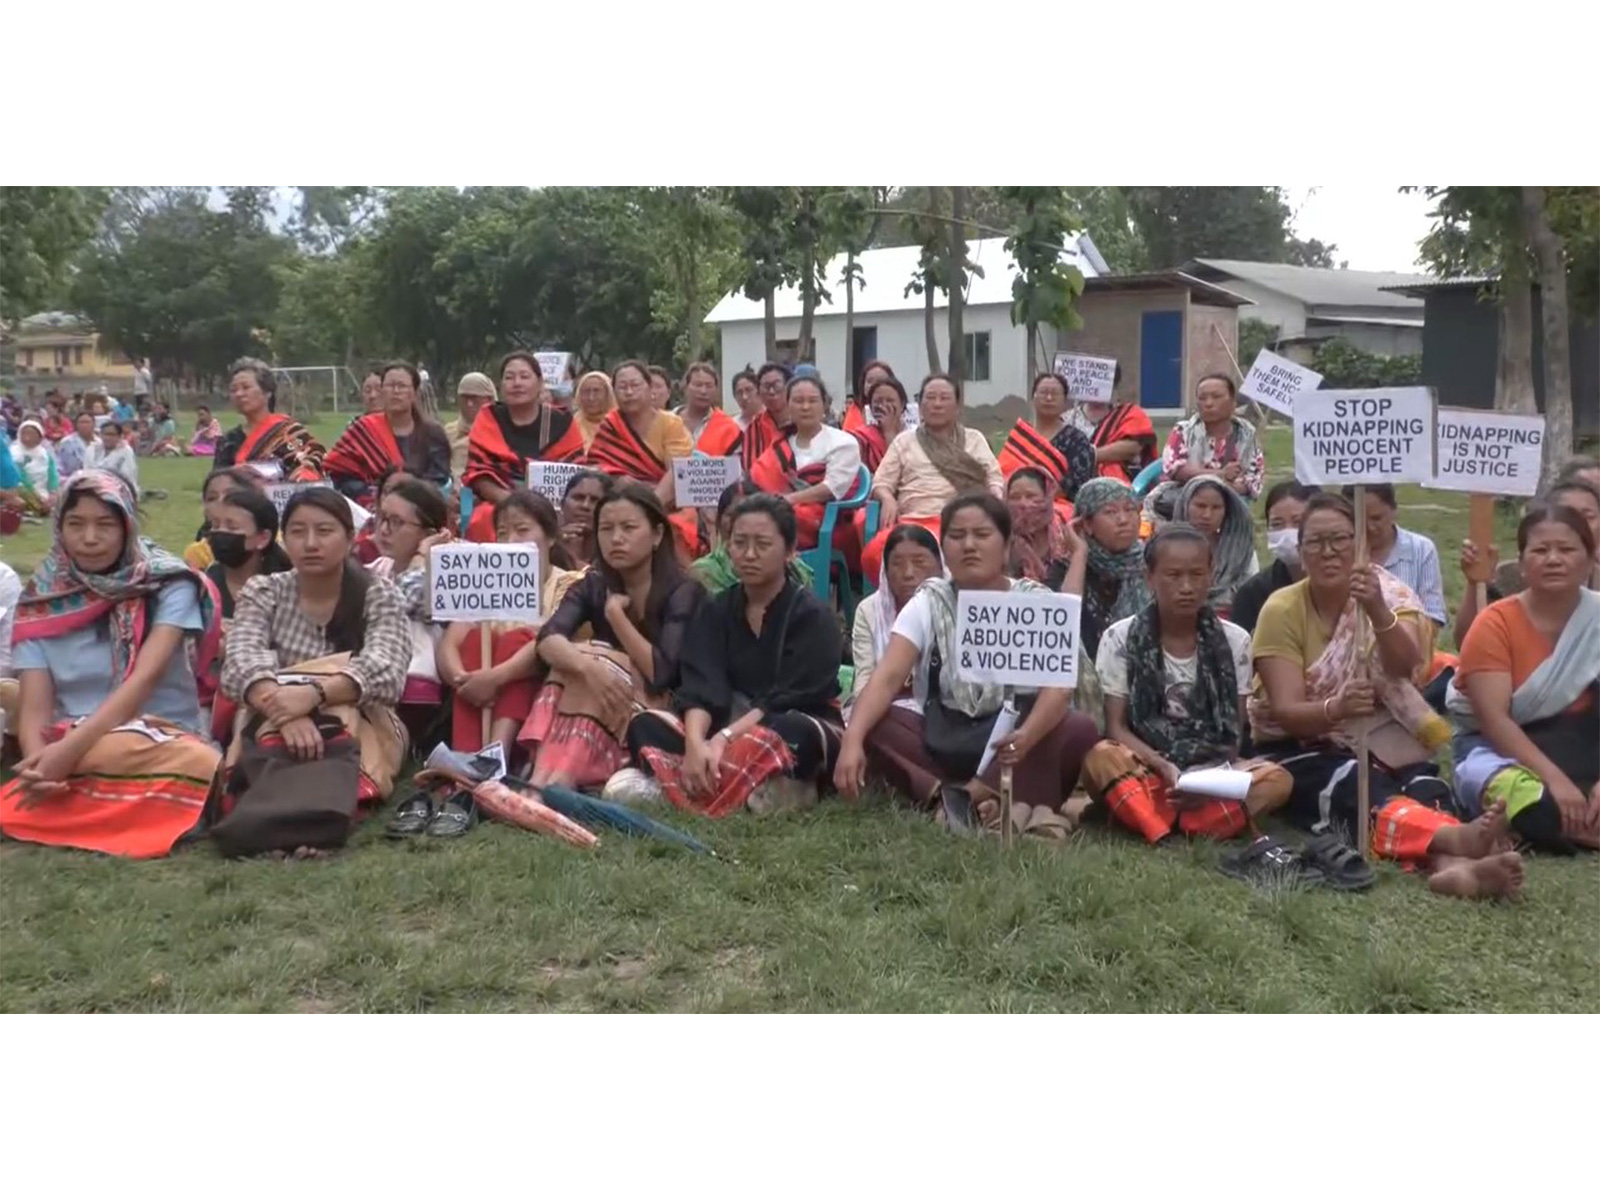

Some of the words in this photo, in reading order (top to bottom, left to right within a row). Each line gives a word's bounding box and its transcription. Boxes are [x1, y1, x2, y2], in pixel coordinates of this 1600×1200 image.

[1079, 360, 1108, 371] STAND
[1079, 368, 1110, 380] PEACE
[1073, 376, 1092, 386] AND
[1252, 366, 1280, 387] THEM
[1270, 365, 1302, 386] BRING
[1069, 385, 1099, 396] USTICE
[1334, 398, 1392, 417] STOP
[1303, 418, 1424, 438] KIDNAPPING
[1438, 424, 1540, 445] IDNAPPING
[1313, 438, 1413, 456] INNOCENT
[1453, 442, 1469, 457] IS
[1475, 443, 1513, 459] NOT
[687, 459, 700, 467] NO
[702, 459, 724, 467] MORE
[1325, 457, 1402, 474] PEOPLE
[1443, 459, 1518, 477] JUSTICE
[543, 475, 571, 485] RIGH
[687, 468, 727, 476] VIOLENCE
[688, 486, 724, 494] INNOCEN
[440, 554, 472, 569] SAY
[478, 553, 502, 569] NO
[507, 552, 530, 568] TO
[435, 573, 535, 590] ABDUCTION
[434, 594, 446, 610] &
[451, 593, 536, 609] VIOLENCE
[967, 605, 1001, 624] SAY
[1007, 607, 1035, 625] NO
[1042, 608, 1068, 626] TO
[961, 628, 1073, 649] ABDUCTION
[961, 651, 972, 668] &
[978, 651, 1072, 672] VIOLENCE
